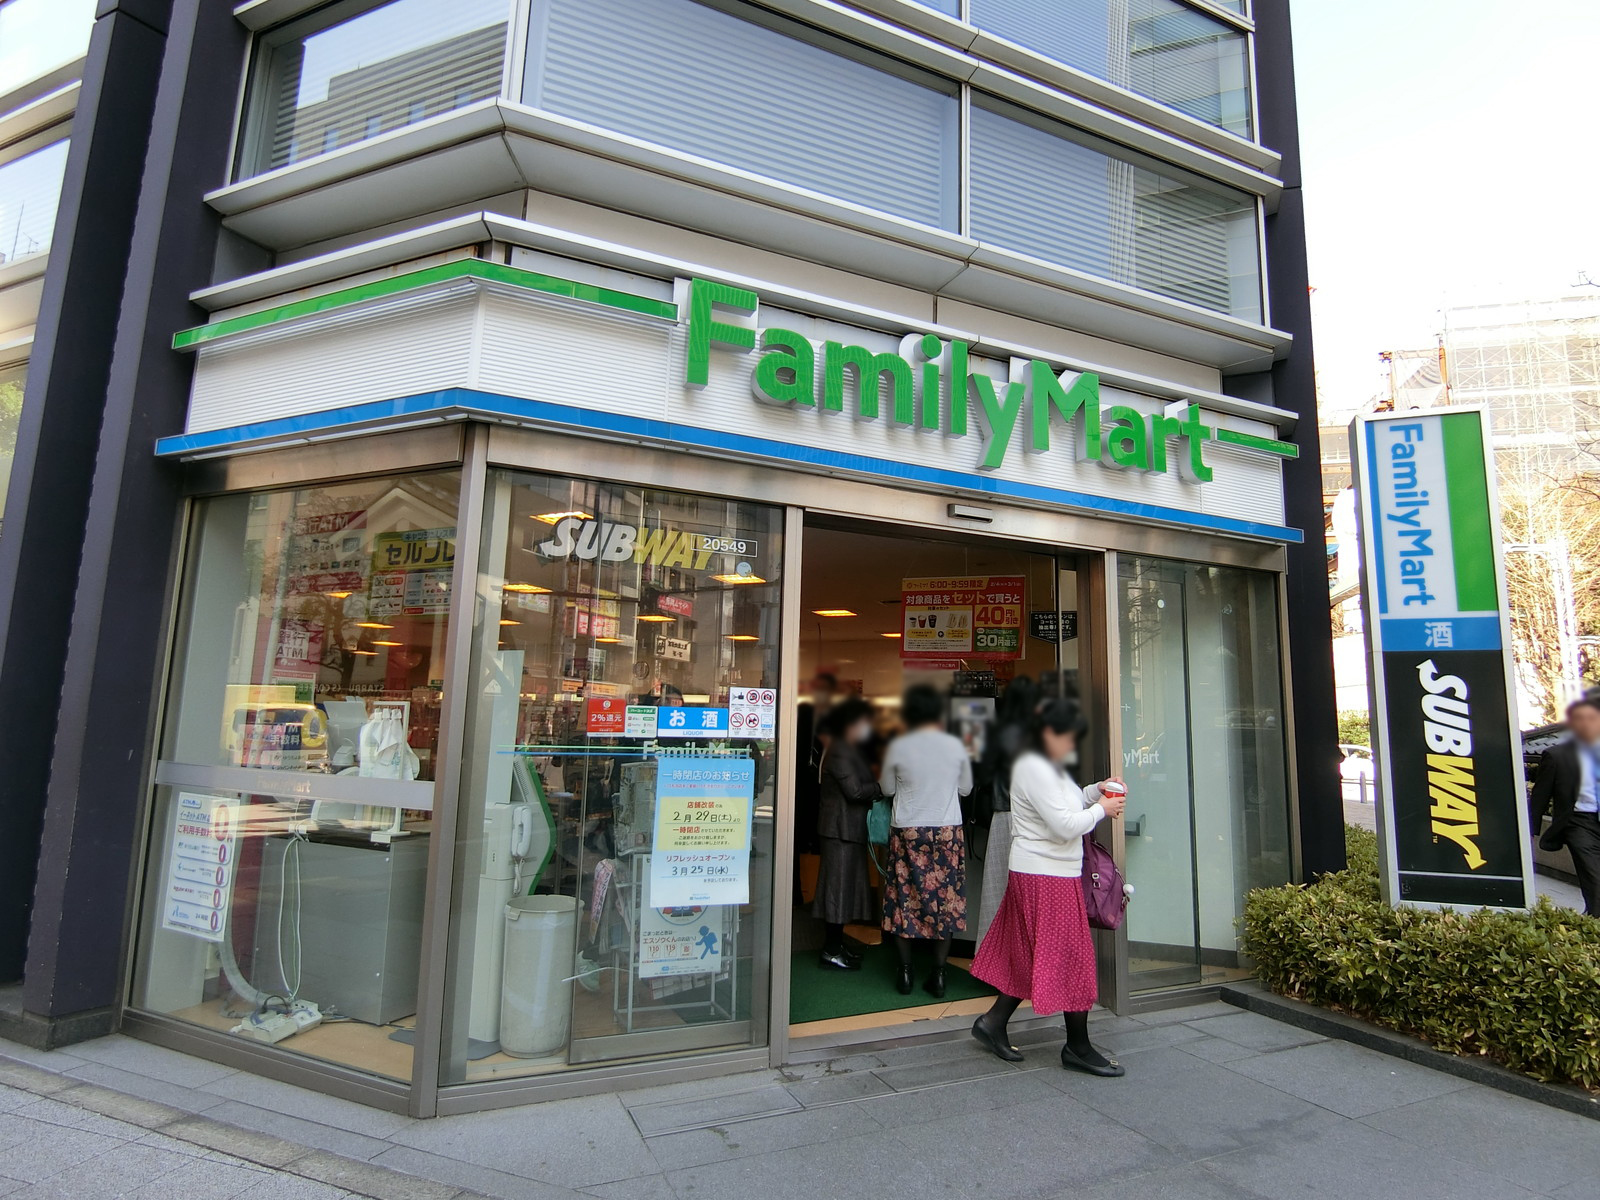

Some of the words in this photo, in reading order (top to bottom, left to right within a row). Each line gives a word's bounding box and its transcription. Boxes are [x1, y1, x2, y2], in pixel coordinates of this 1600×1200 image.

[683, 277, 1213, 485] FamilyMart
[1387, 423, 1436, 606] FamilyMart
[540, 518, 717, 571] SUBWAY
[702, 537, 748, 554] 20549
[1424, 621, 1453, 648] 酒
[663, 770, 750, 781] 一時閉店のお知らせ
[1416, 659, 1487, 870] SUBWAY
